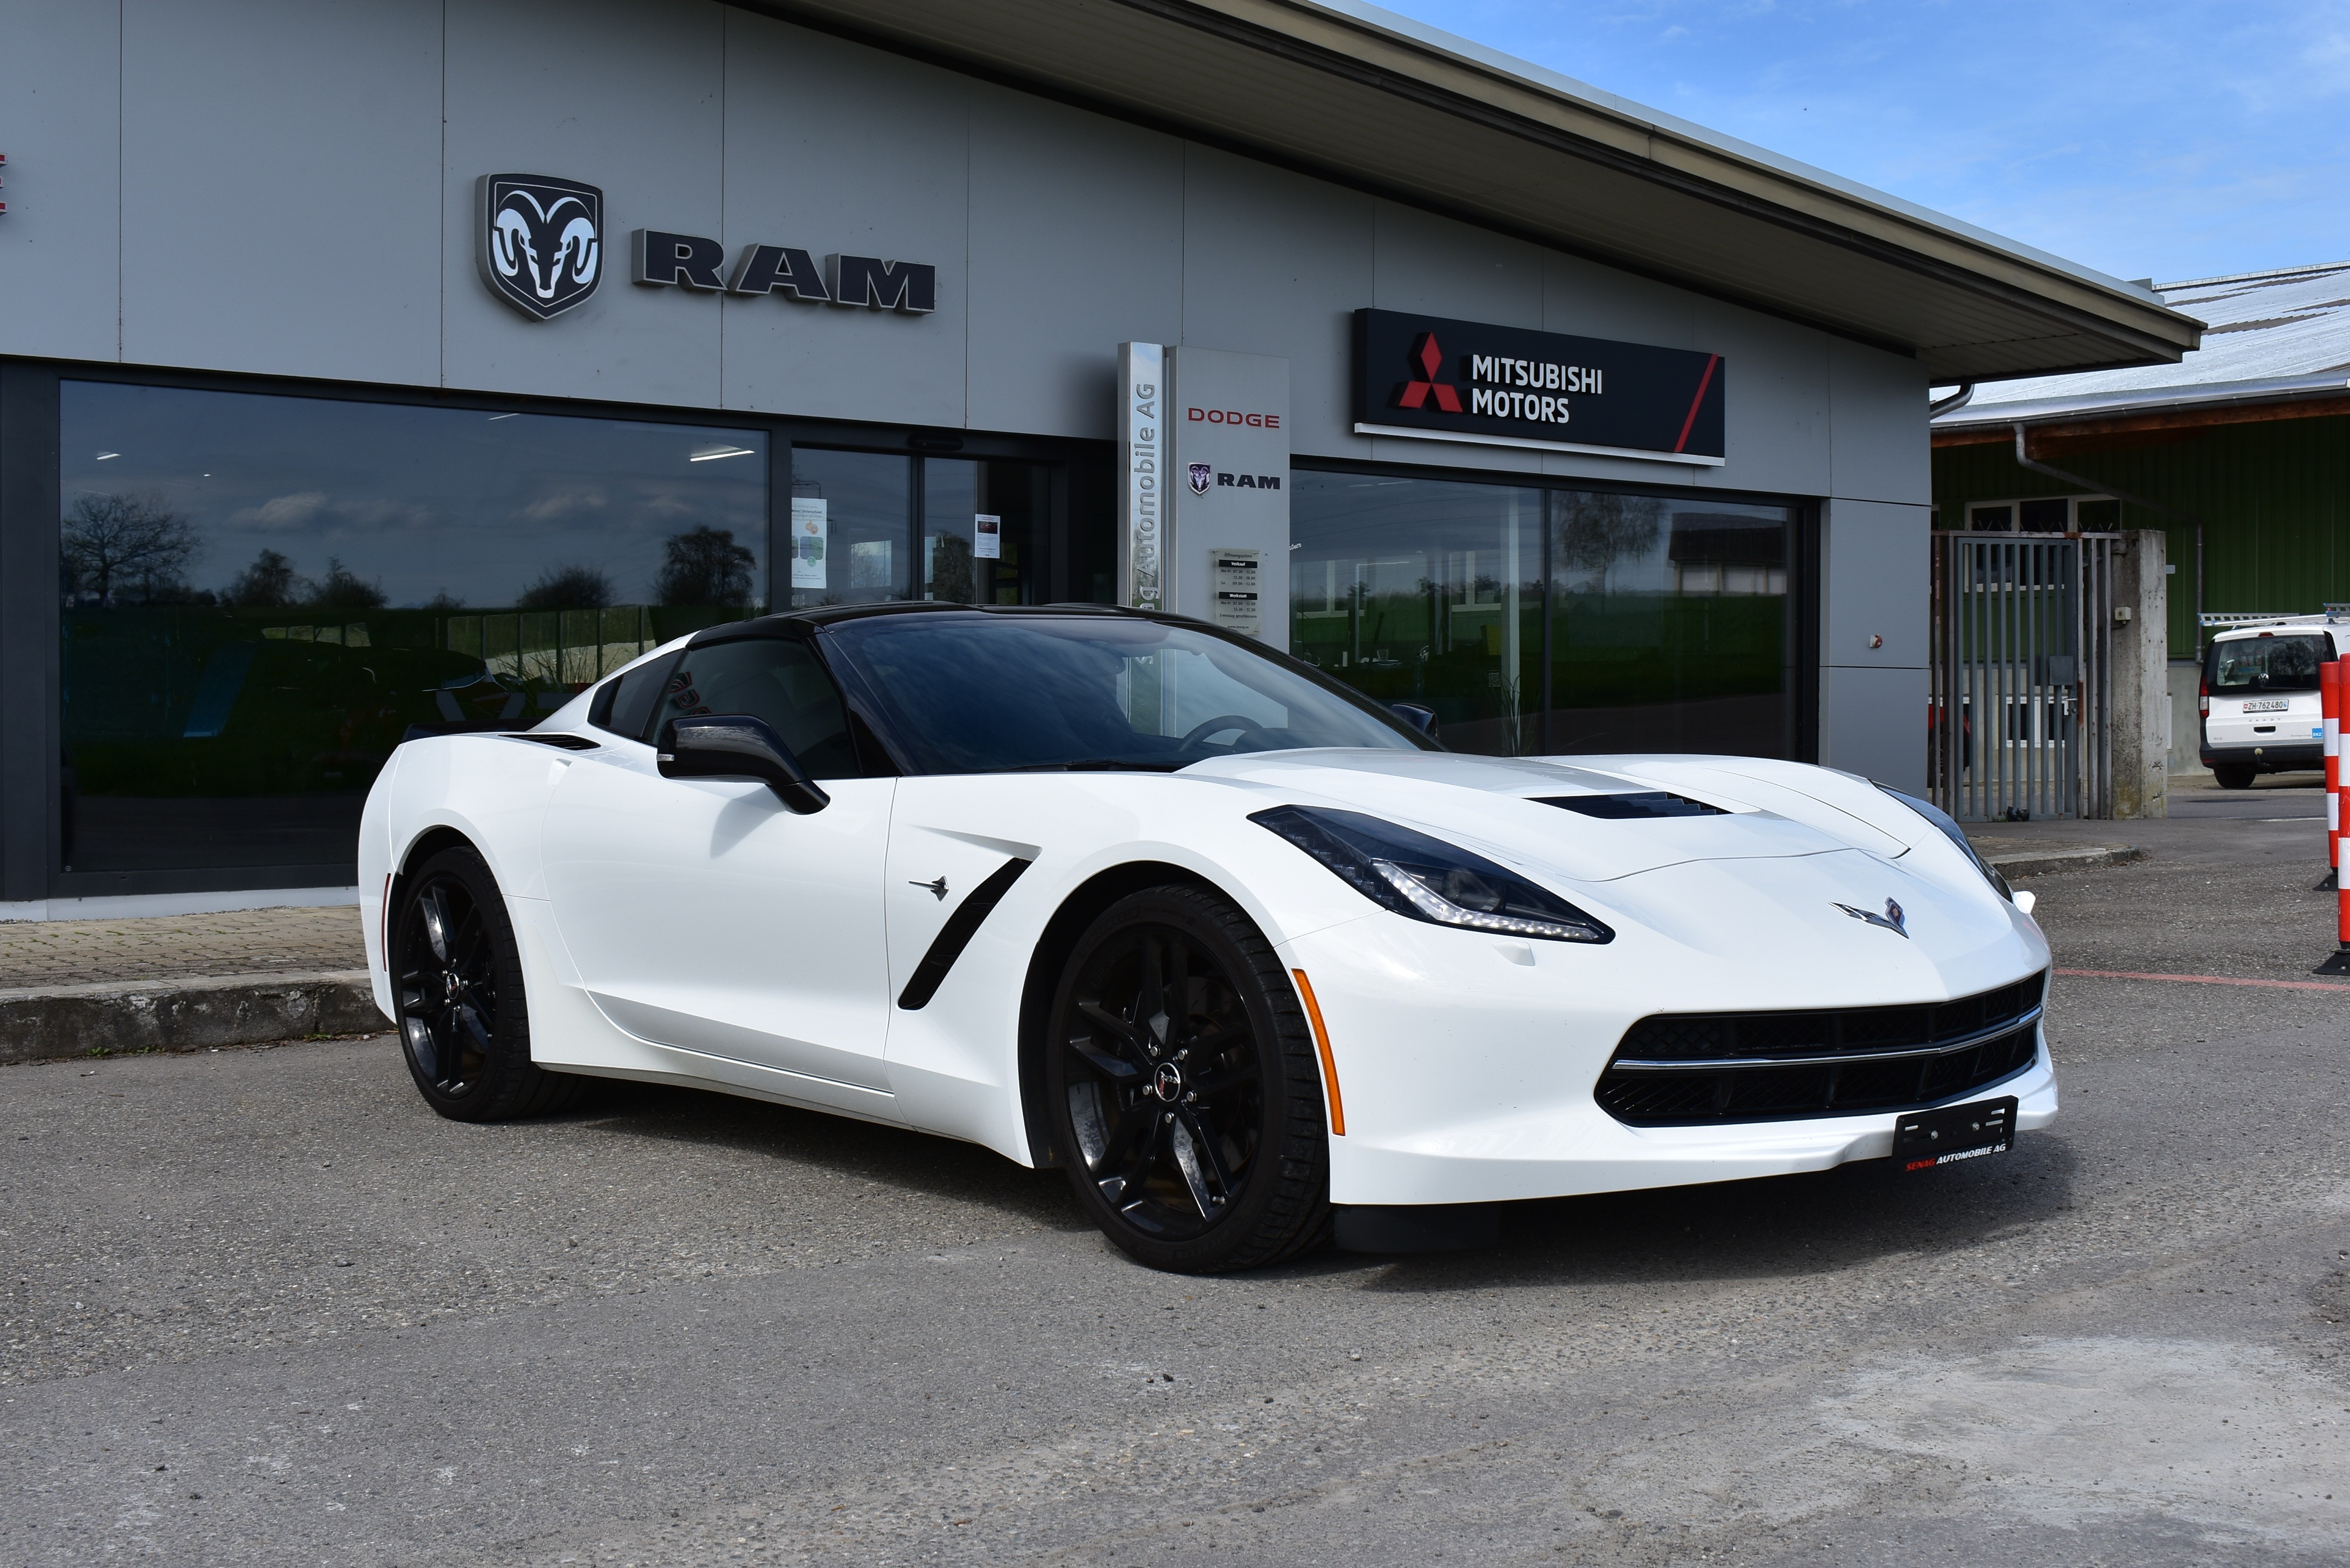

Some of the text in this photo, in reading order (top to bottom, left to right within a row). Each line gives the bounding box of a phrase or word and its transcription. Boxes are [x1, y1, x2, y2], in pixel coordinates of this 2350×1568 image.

[632, 228, 936, 315] RAM
[1472, 354, 1603, 395] MITSUBISHI
[1136, 383, 1155, 419] AG
[1188, 407, 1280, 429] DODGE
[1472, 388, 1569, 424] MOTORS
[1217, 472, 1281, 490] RAM
[1134, 426, 1155, 578] Automobile
[1906, 1143, 2006, 1171] SENAG AUTOMOBILE AG
